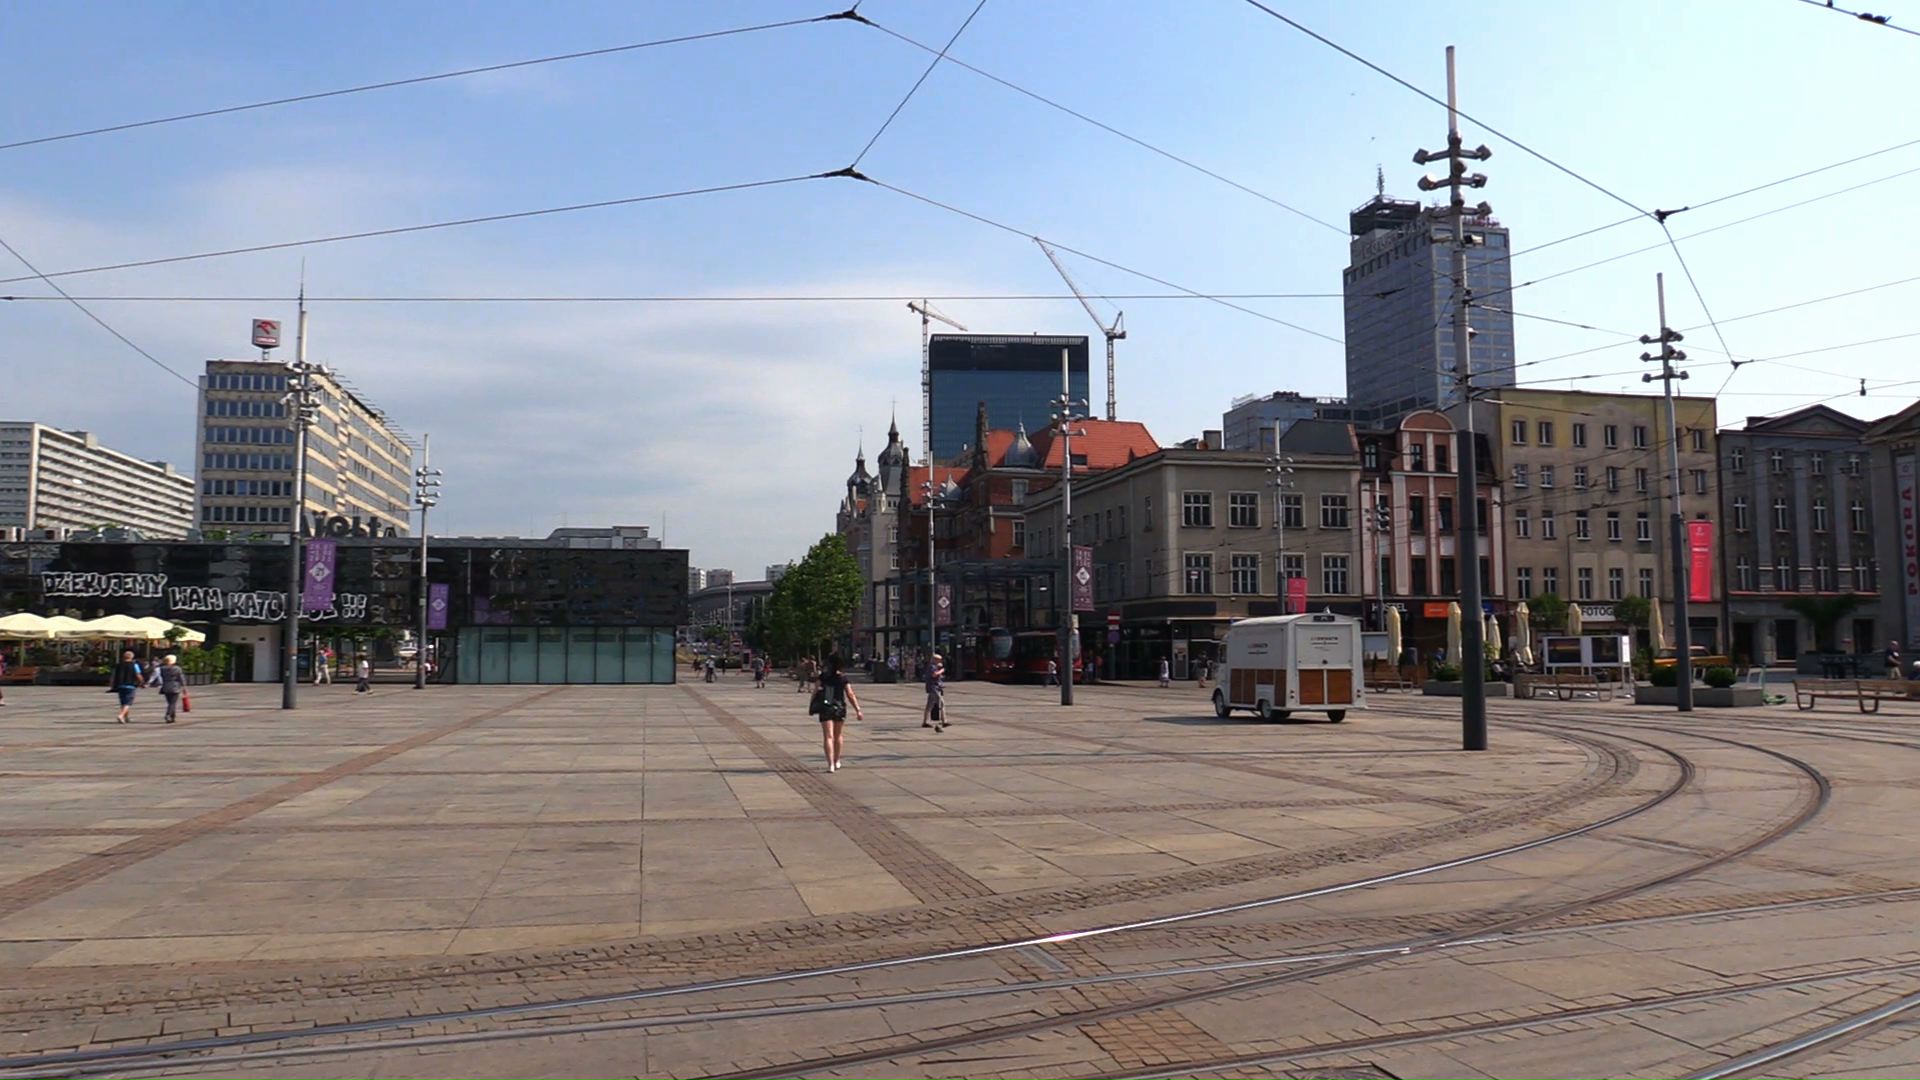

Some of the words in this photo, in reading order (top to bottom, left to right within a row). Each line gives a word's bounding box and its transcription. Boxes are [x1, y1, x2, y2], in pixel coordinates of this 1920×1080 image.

[1902, 487, 1918, 596] POKORA
[168, 586, 224, 610] WAM
[1371, 600, 1408, 612] HSTEL
